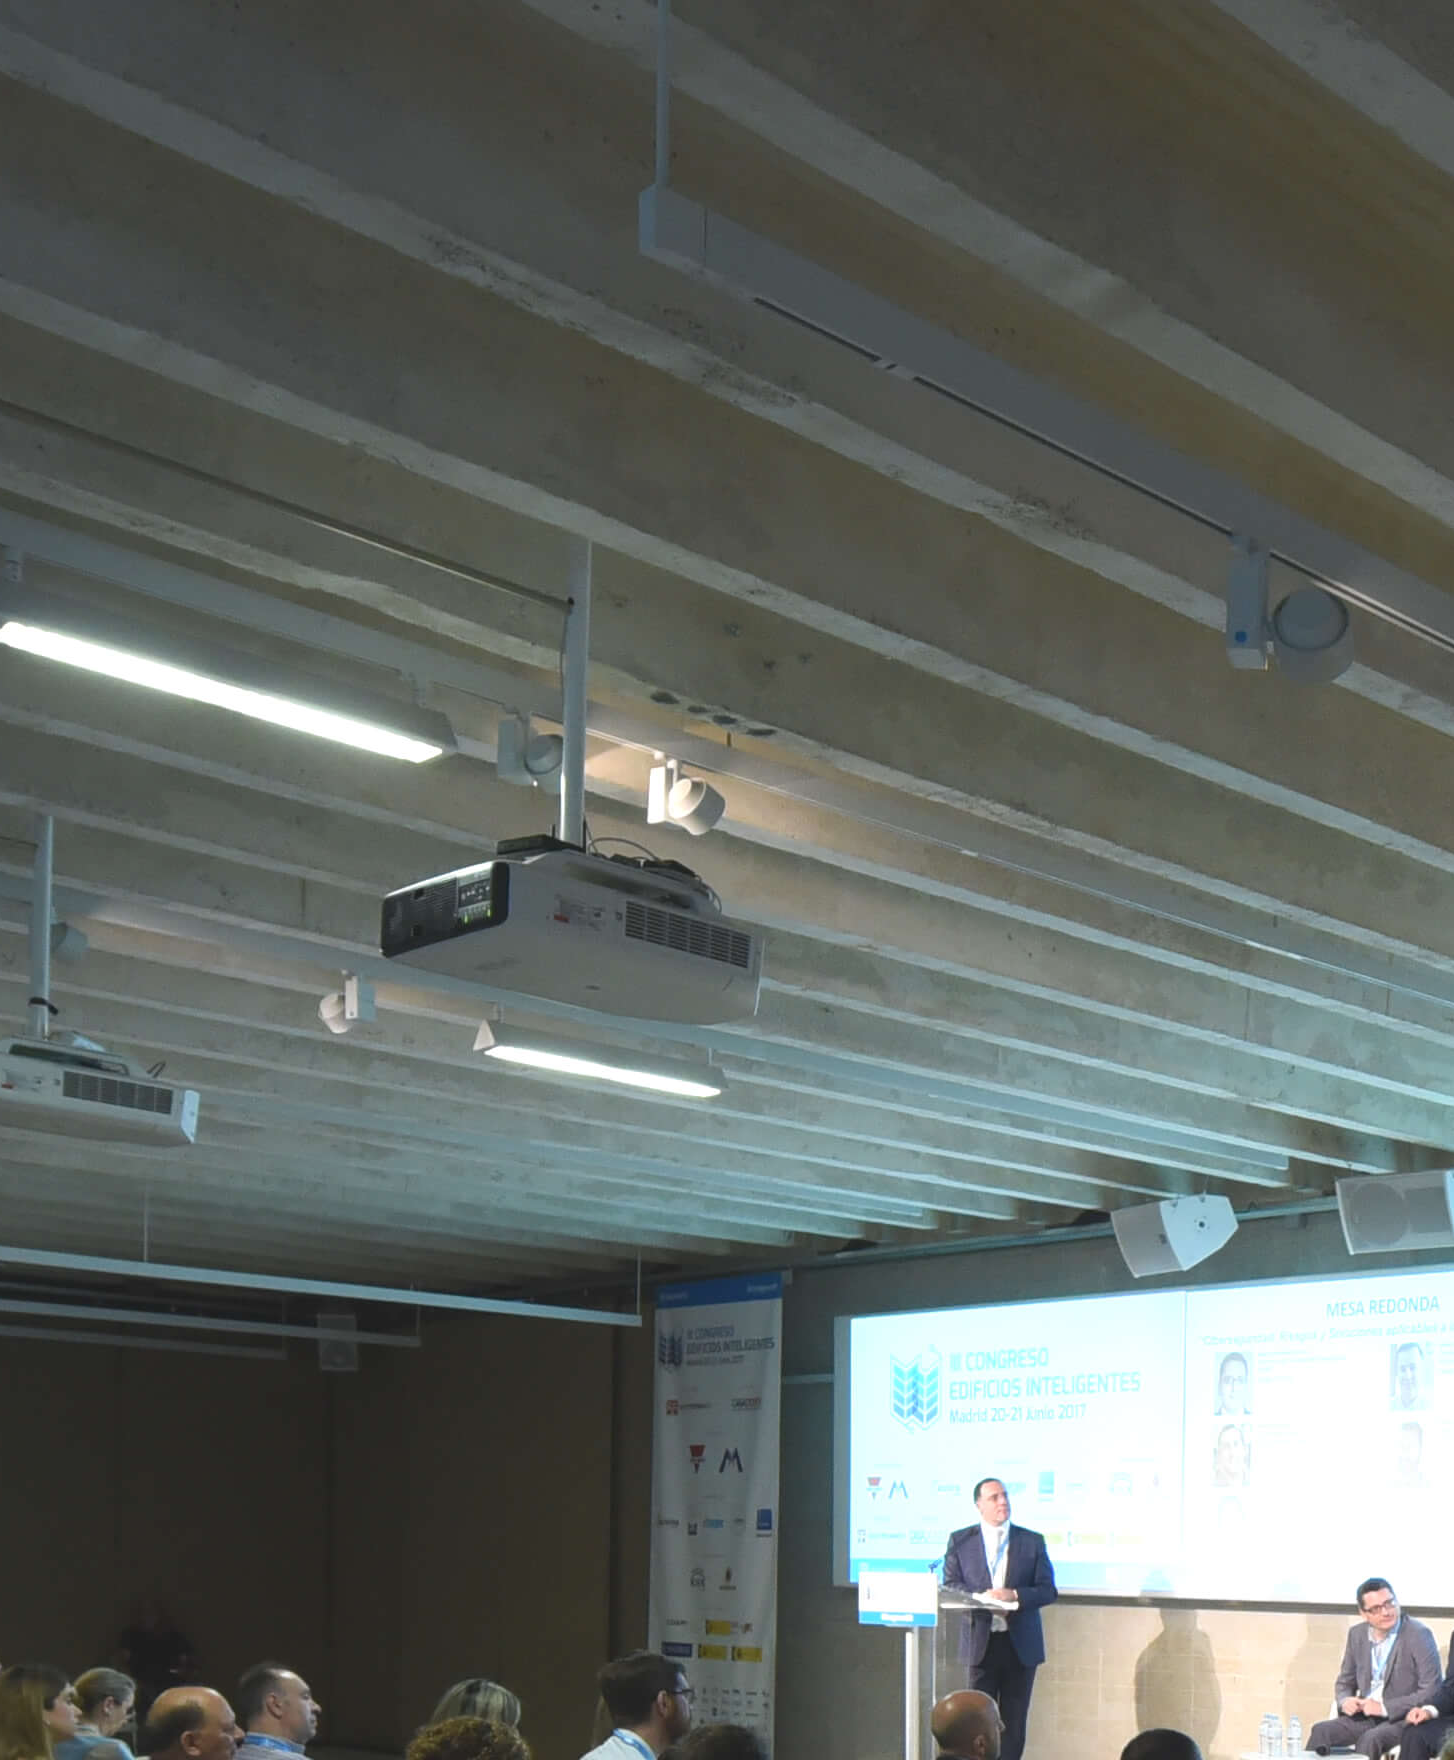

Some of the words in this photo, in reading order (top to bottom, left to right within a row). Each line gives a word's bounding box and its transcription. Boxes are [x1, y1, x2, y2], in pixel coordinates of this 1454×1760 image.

[1326, 1302, 1365, 1319] MESA
[1369, 1296, 1441, 1316] REDONDA
[965, 1346, 1049, 1371] CONGRESO
[949, 1375, 1021, 1401] EDIFICIOS
[1026, 1370, 1141, 1397] INTELIGENTES
[1058, 1402, 1087, 1420] 2017
